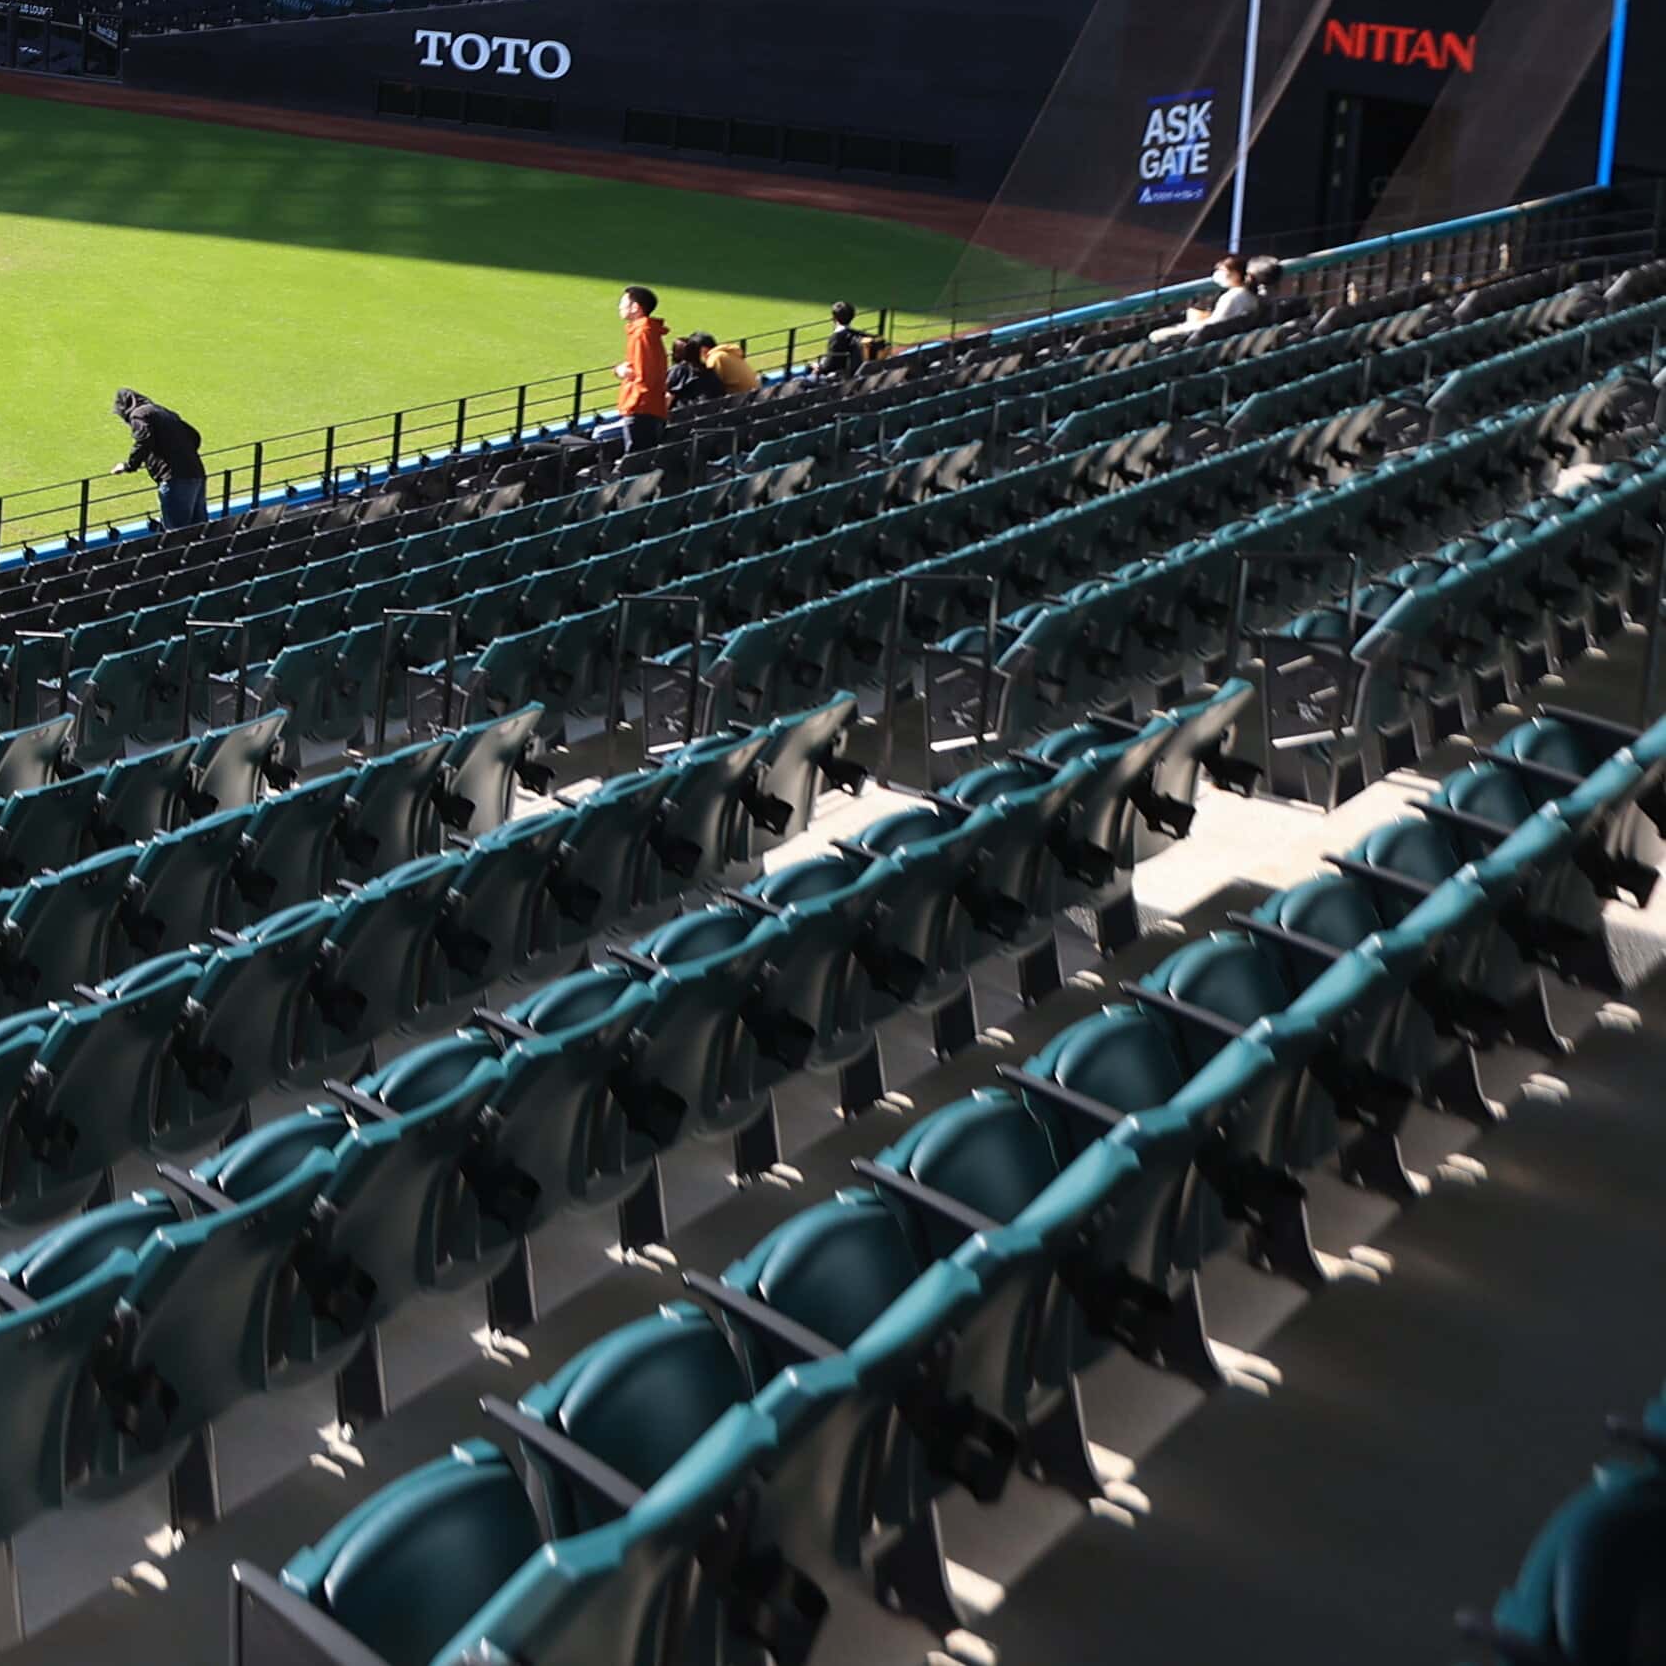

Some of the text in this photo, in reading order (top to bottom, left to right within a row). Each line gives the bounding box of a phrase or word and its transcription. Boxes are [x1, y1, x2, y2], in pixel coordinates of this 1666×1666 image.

[414, 28, 571, 80] TOTO
[1322, 18, 1477, 74] NITTAN
[1141, 99, 1213, 147] ASK
[1138, 141, 1211, 180] GATE
